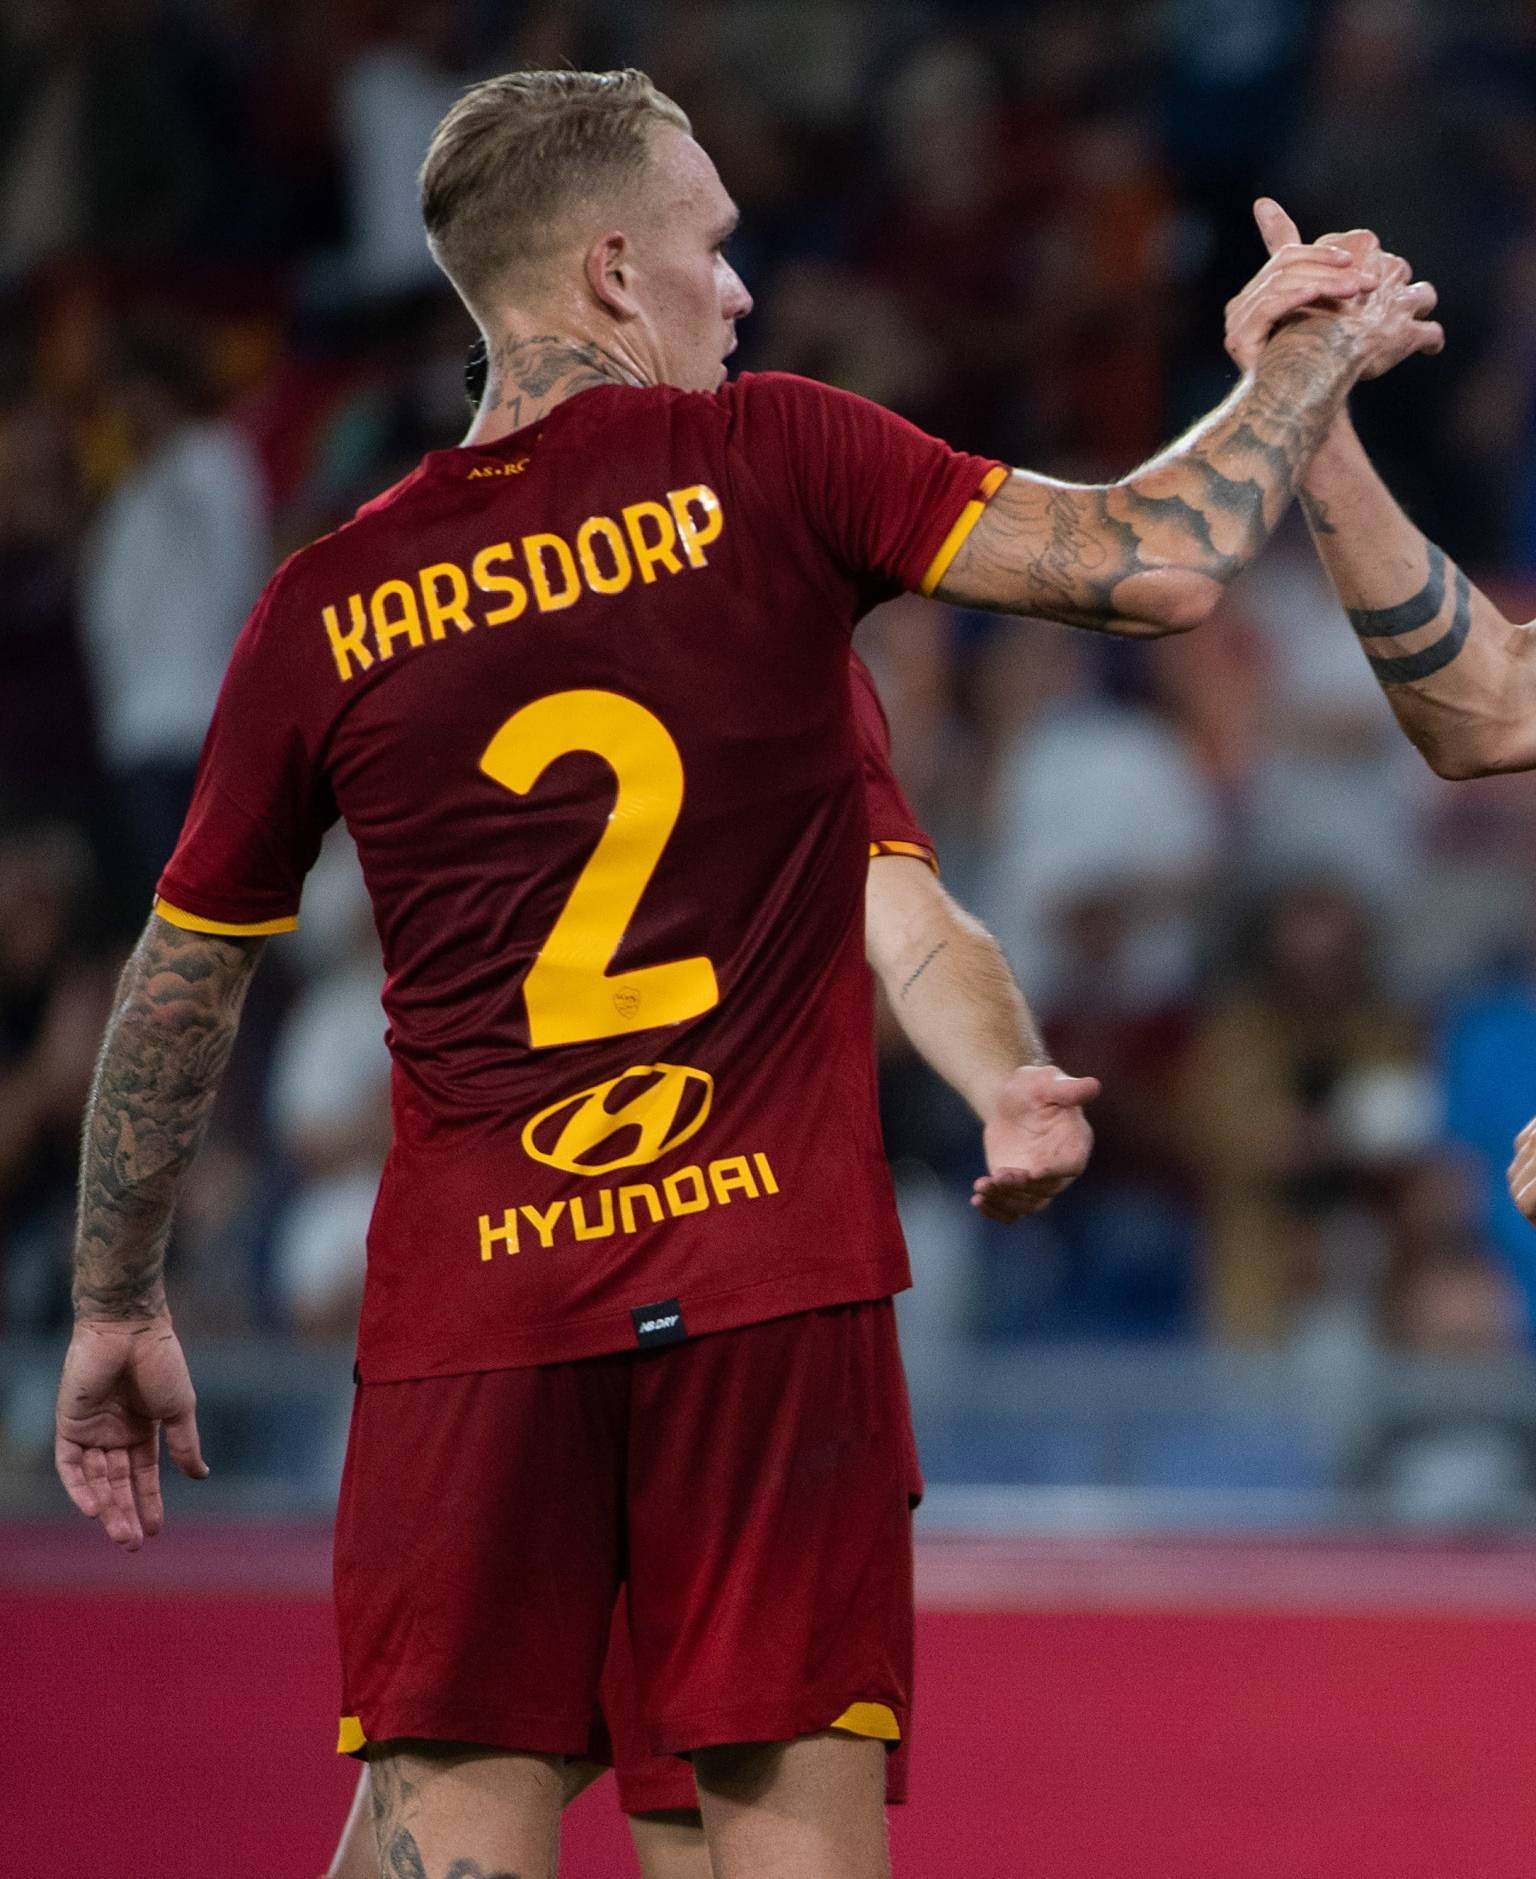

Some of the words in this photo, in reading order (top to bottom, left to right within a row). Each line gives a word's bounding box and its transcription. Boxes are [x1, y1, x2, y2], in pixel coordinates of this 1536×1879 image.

[321, 483, 724, 682] KARSDORP
[479, 688, 719, 1049] 2
[478, 1152, 780, 1262] HYUNDAI
